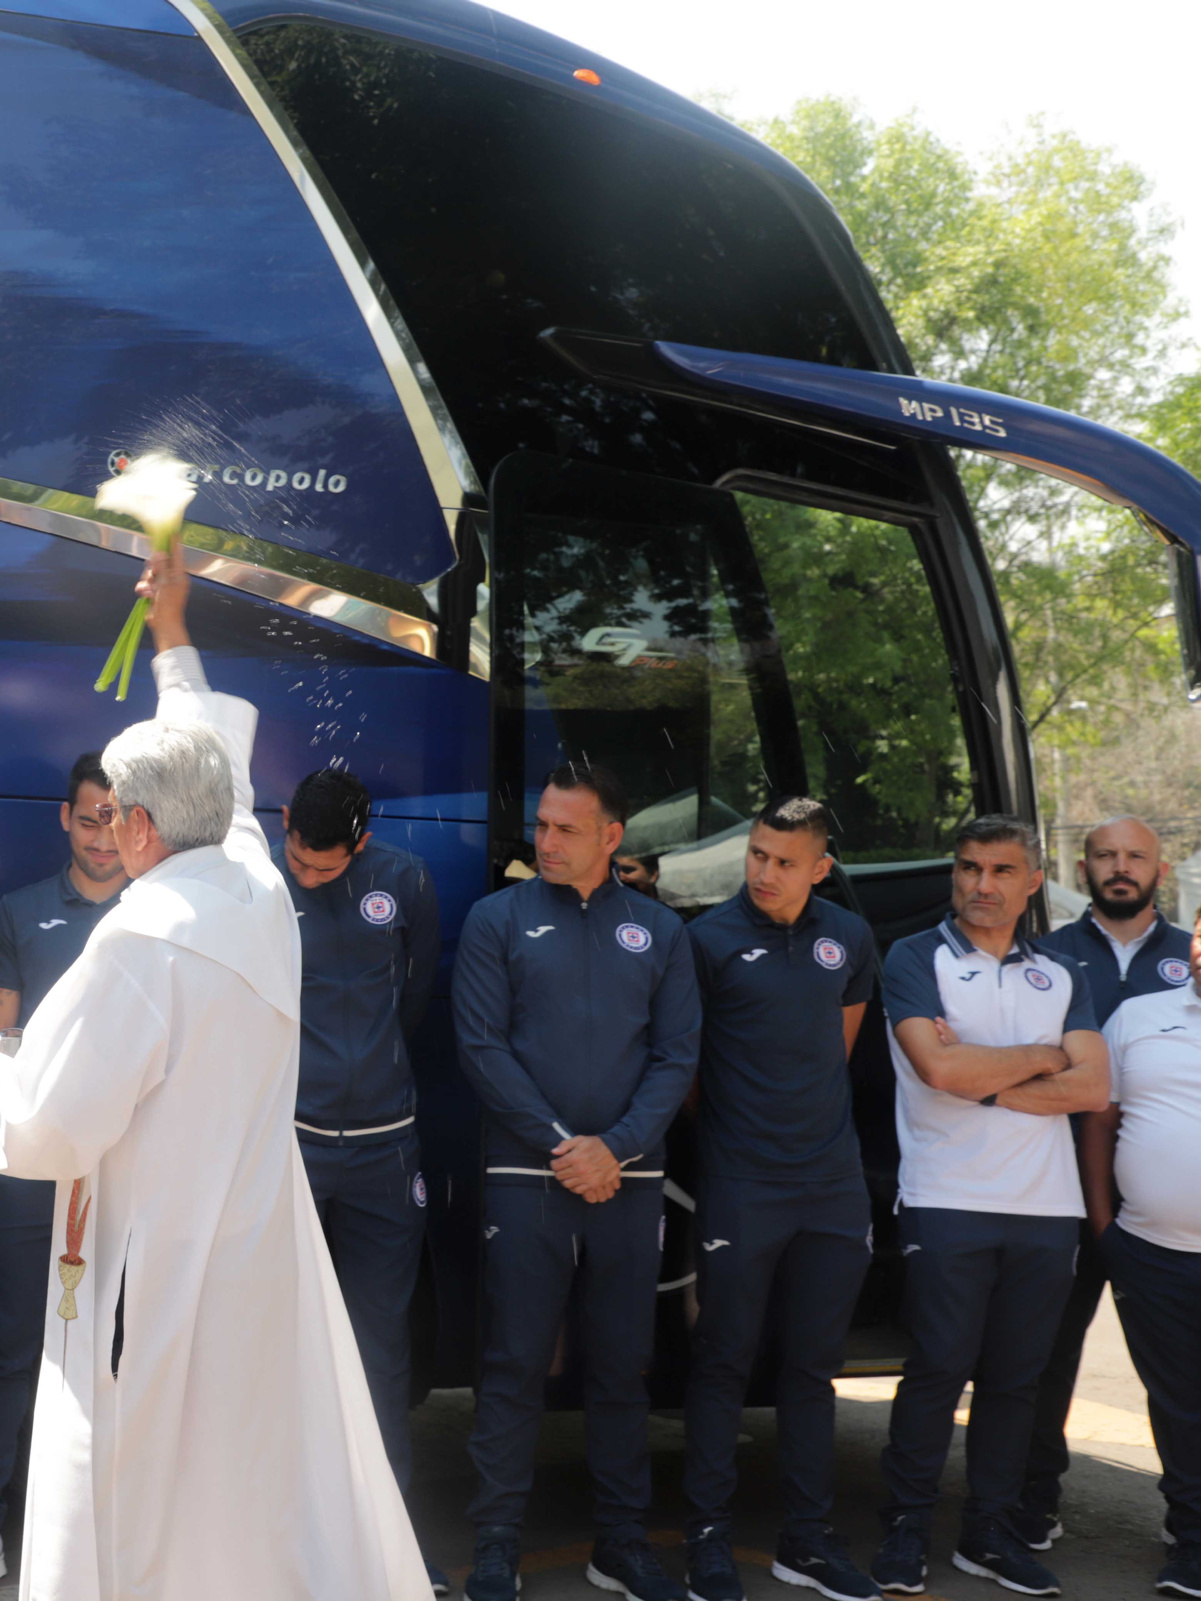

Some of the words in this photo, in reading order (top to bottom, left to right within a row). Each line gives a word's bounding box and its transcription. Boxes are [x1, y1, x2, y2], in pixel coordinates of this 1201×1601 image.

[898, 396, 944, 421] MP
[949, 406, 1008, 437] 135
[185, 464, 348, 493] arcopolo
